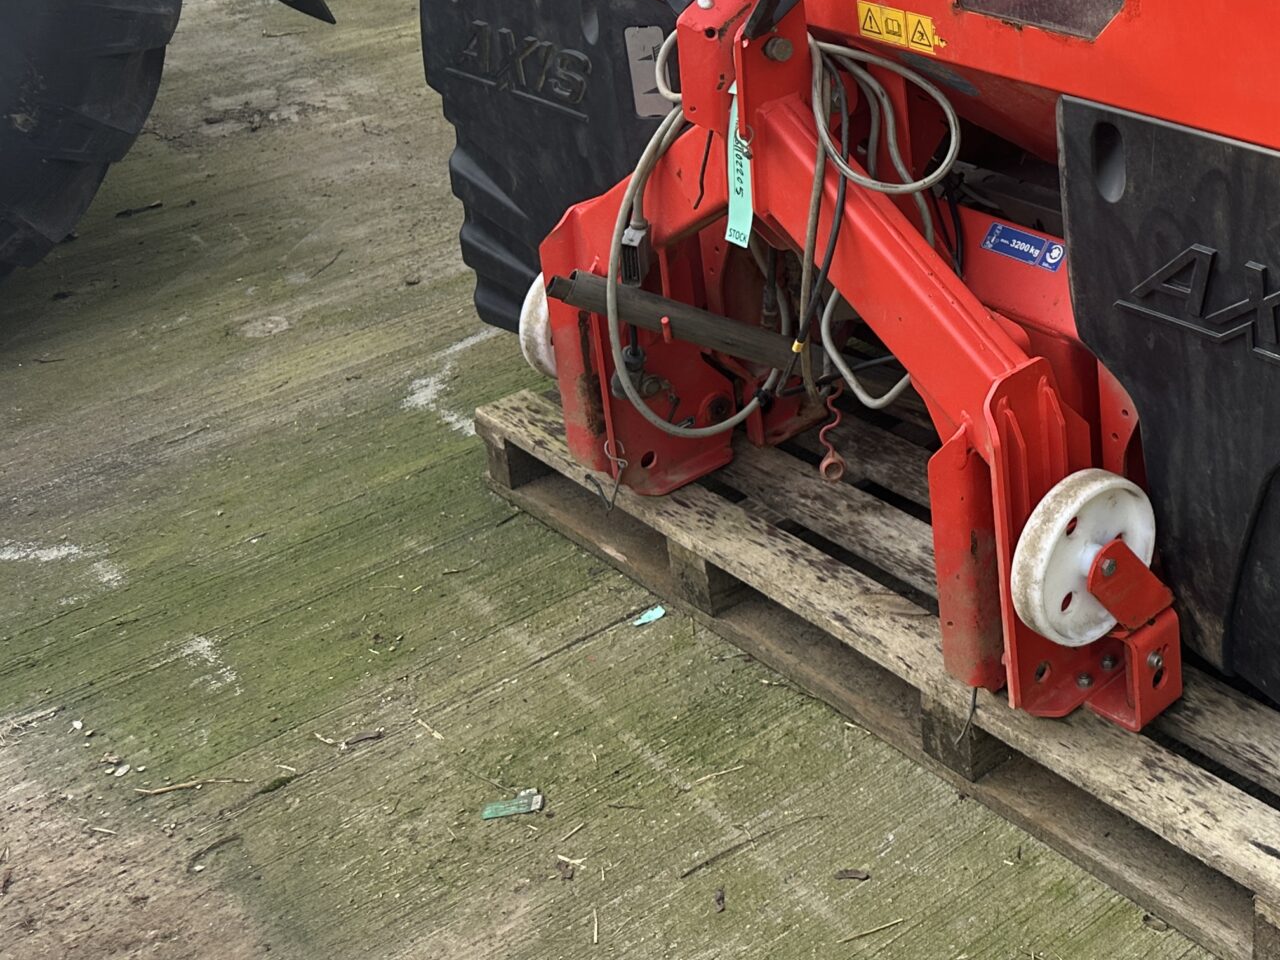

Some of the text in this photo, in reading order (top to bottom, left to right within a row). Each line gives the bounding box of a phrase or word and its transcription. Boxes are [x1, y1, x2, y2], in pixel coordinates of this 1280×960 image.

[460, 20, 592, 104] AXIS
[728, 227, 747, 244] STOCK
[1010, 239, 1030, 252] 3200
[1030, 246, 1040, 258] kg
